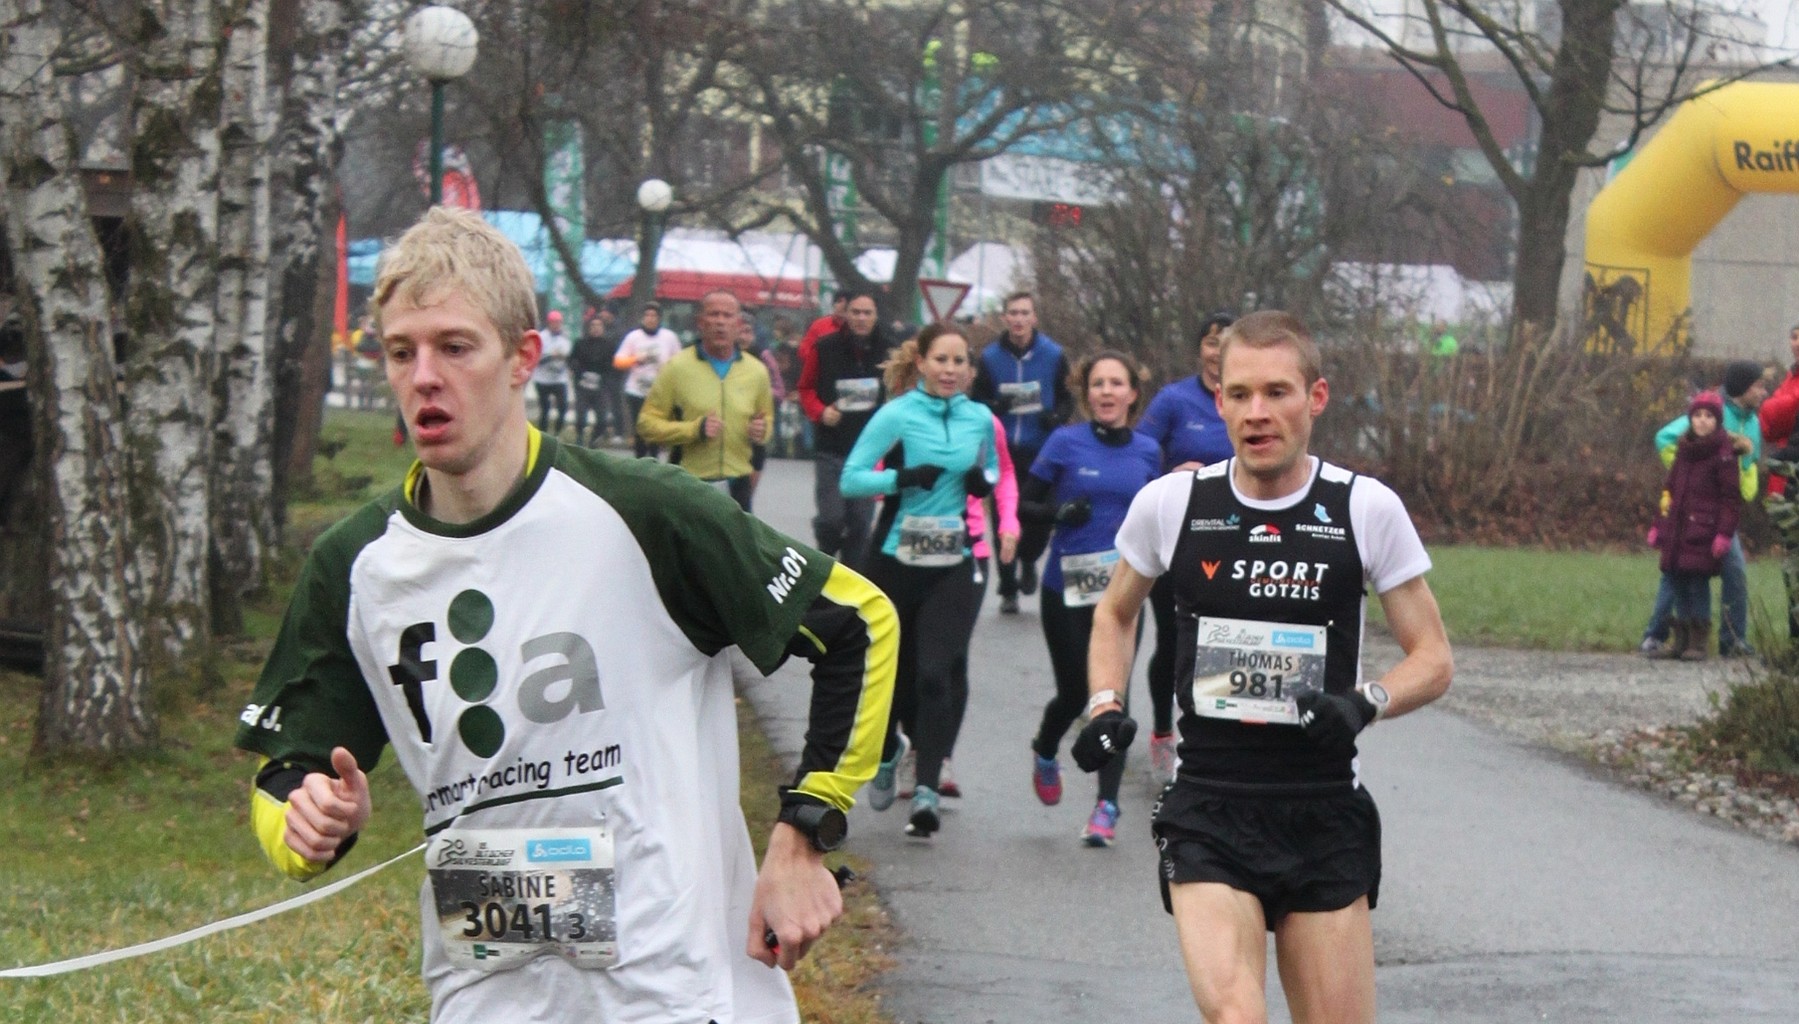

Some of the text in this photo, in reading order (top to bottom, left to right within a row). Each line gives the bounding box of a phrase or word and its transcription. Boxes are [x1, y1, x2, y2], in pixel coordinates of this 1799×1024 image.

[1249, 534, 1281, 543] skinfit
[766, 546, 808, 604] Nr.01
[1074, 569, 1110, 590] 106
[1231, 559, 1329, 582] SPORT
[1229, 651, 1292, 671] THOMAS
[1229, 670, 1284, 699] 981
[564, 743, 621, 776] team
[479, 875, 556, 899] SABINE
[460, 901, 586, 939] 3041 3
